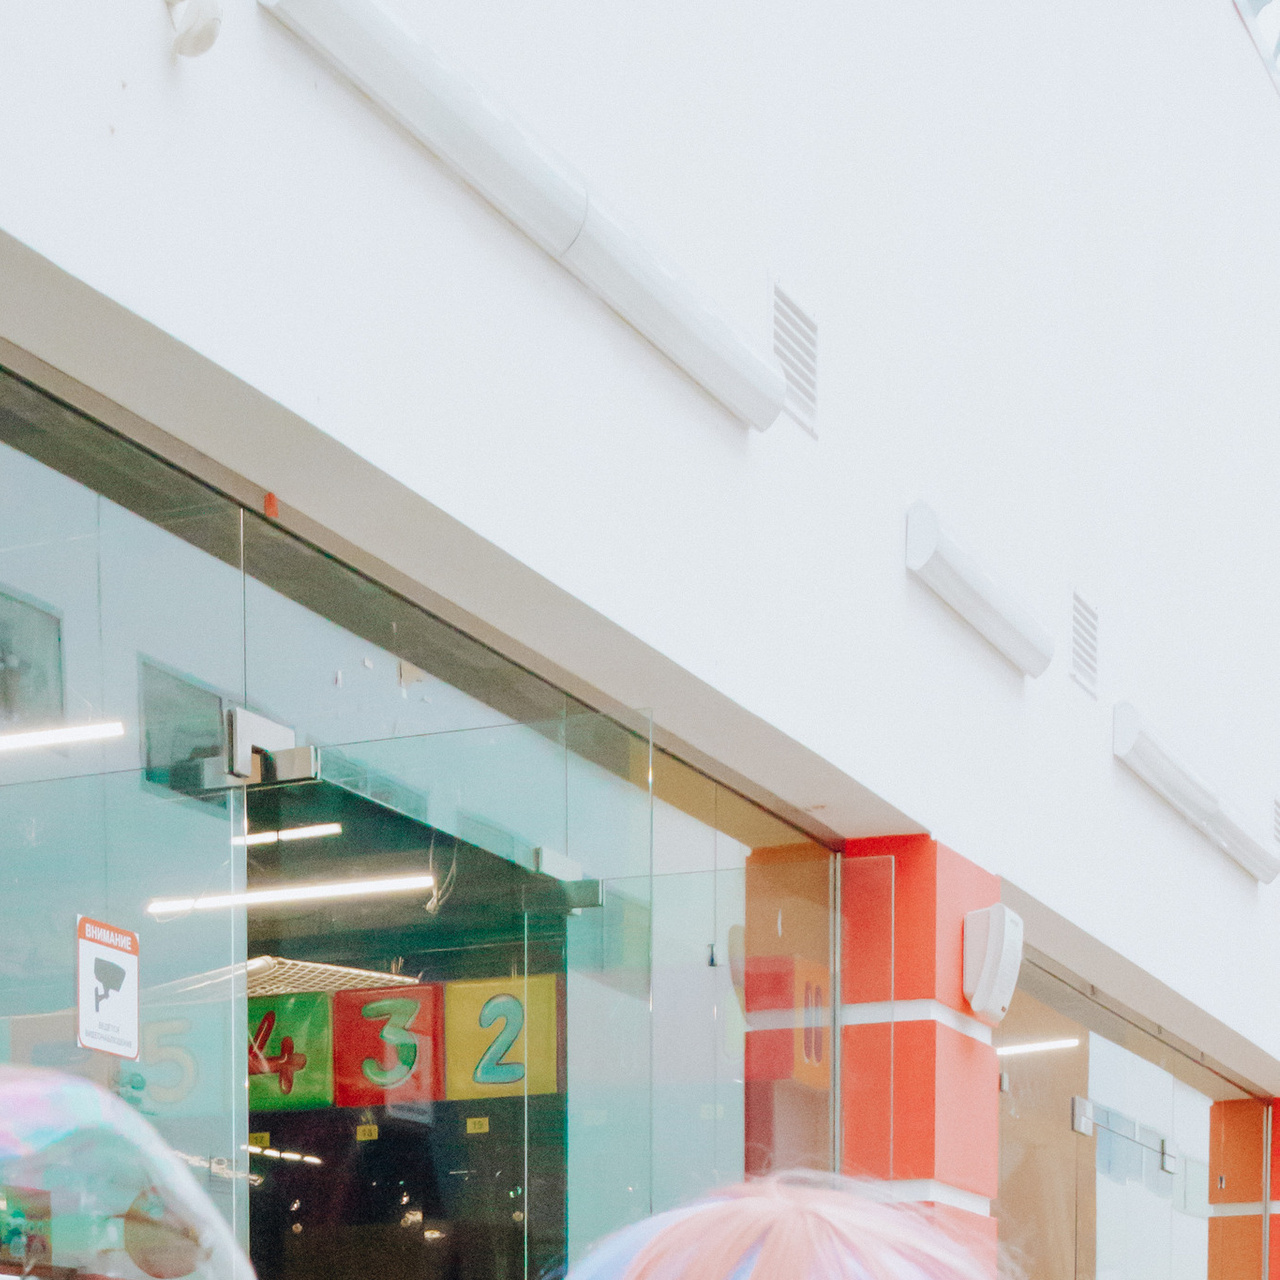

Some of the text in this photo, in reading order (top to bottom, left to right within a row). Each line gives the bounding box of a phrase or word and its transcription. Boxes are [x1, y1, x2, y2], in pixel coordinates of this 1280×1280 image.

[85, 923, 132, 951] ВНИМАНИЕ
[248, 1010, 307, 1094] 4
[361, 998, 420, 1089] 3
[473, 993, 526, 1084] 2
